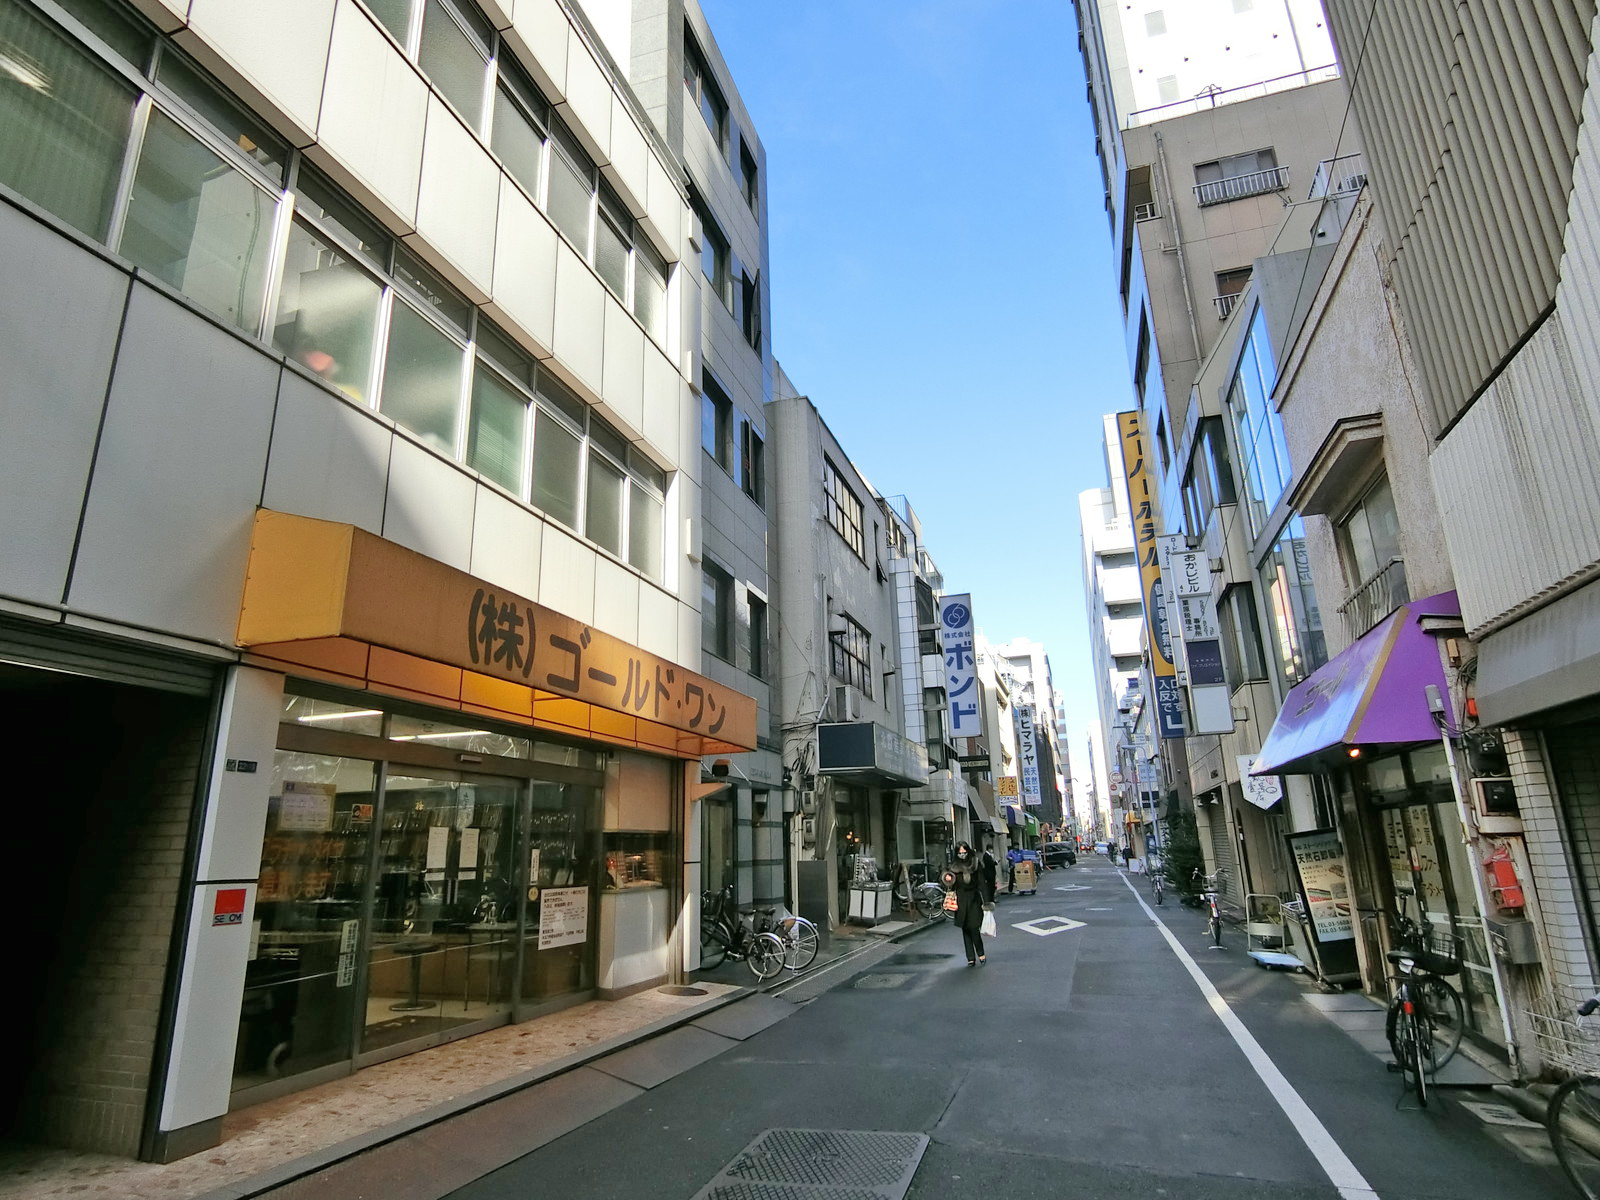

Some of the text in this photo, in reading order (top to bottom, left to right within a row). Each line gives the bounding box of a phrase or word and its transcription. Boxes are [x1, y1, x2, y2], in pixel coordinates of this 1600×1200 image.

[1184, 554, 1200, 592] おかじビル
[944, 631, 971, 639] 株式会社
[945, 641, 976, 729] ボンド
[1031, 767, 1039, 794] 天然石
[215, 914, 242, 923] SEOM
